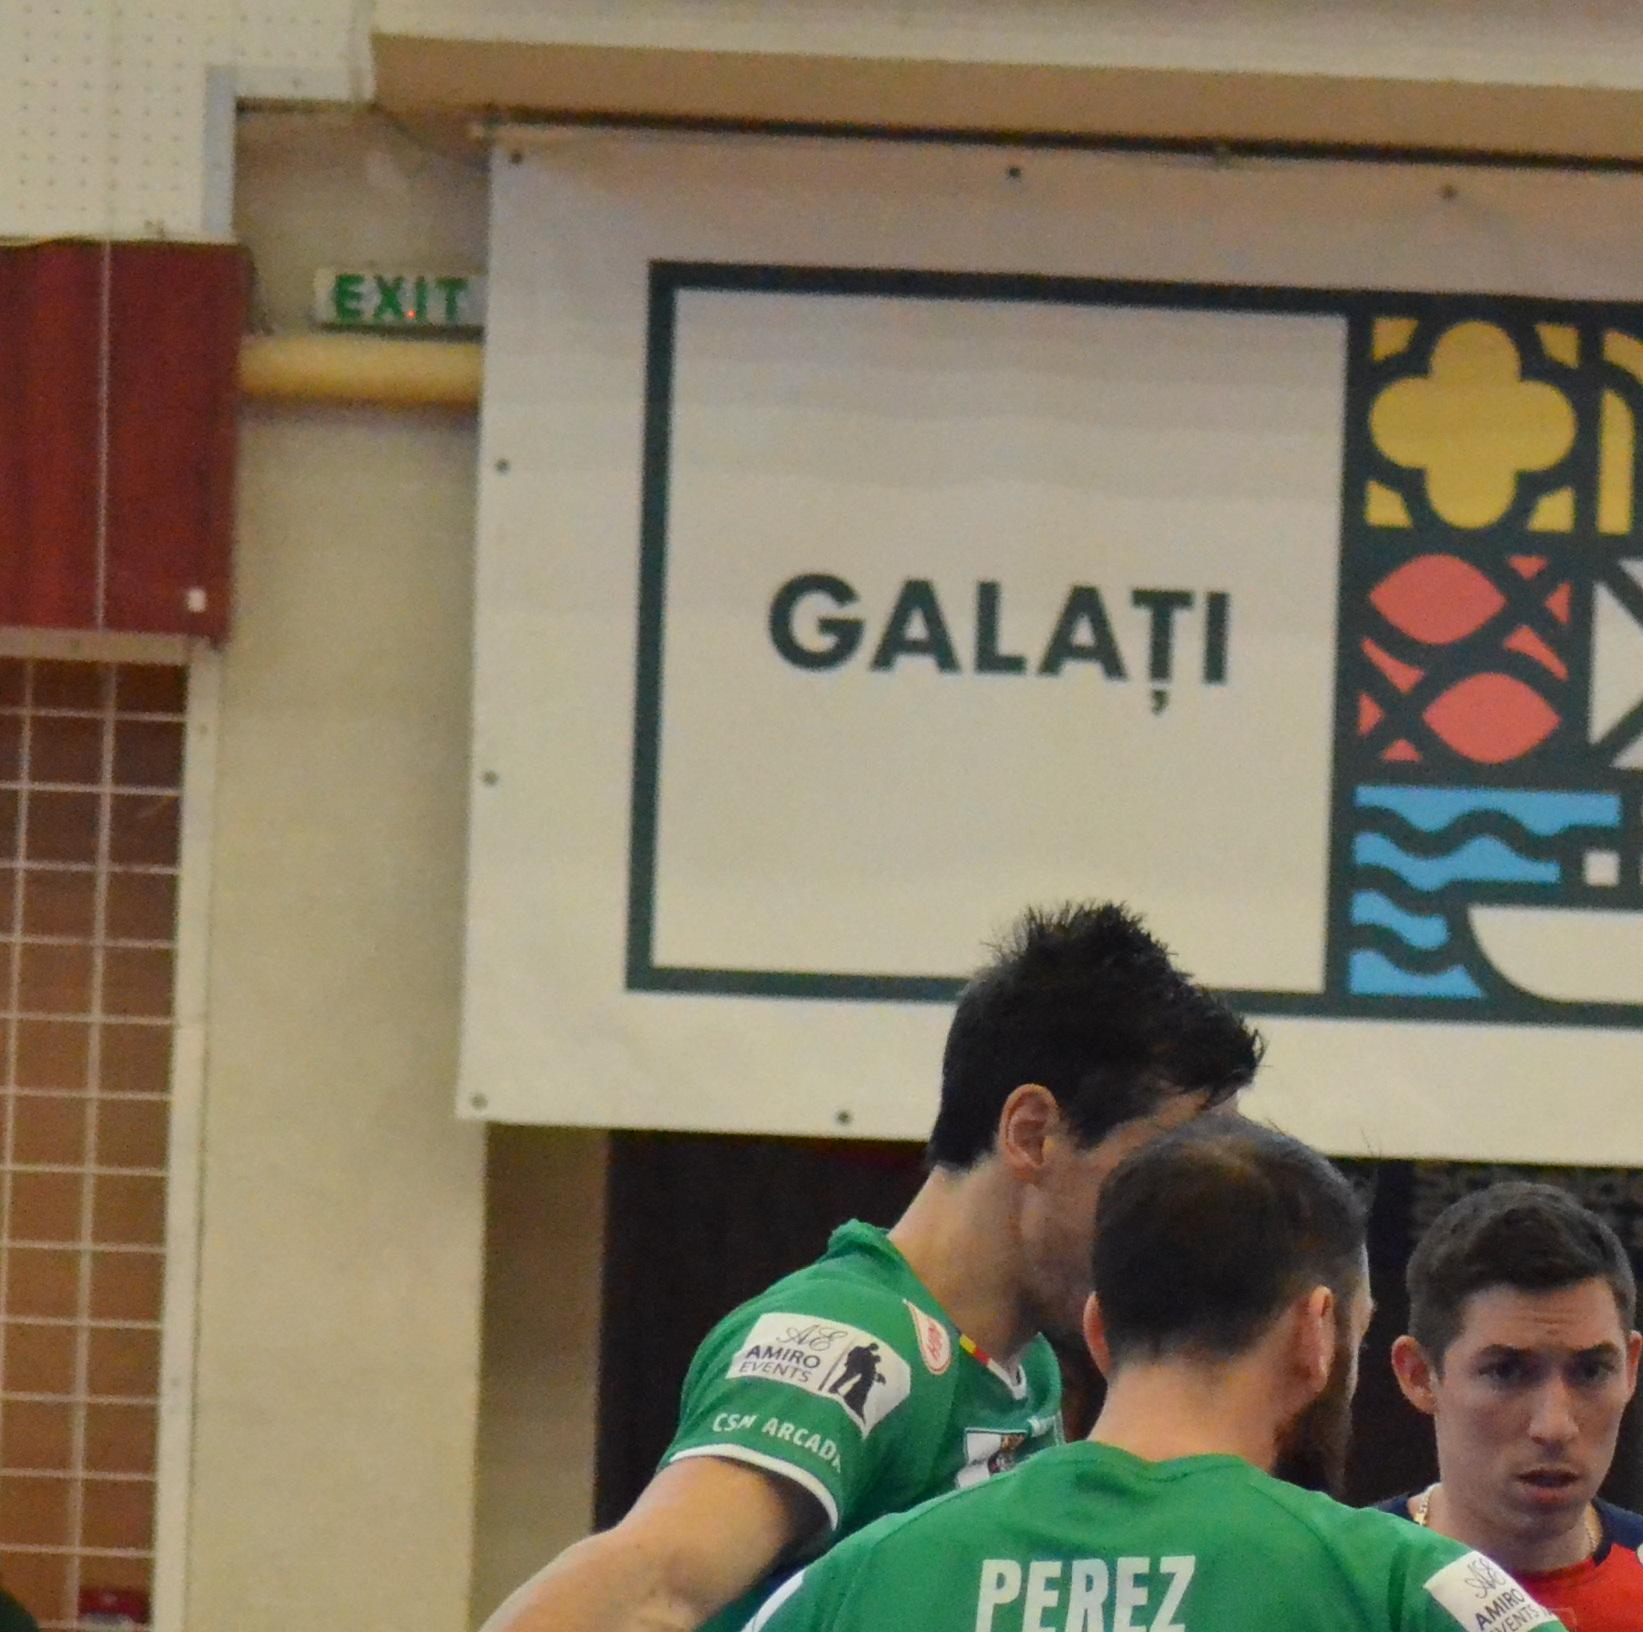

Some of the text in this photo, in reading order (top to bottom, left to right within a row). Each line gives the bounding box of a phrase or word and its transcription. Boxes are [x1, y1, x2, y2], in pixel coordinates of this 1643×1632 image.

[333, 271, 468, 321] EXIT
[768, 573, 1229, 712] GALAȚI
[739, 1361, 816, 1383] EVENTS
[745, 1344, 821, 1369] AMIRO
[713, 1413, 758, 1432] CSM
[1475, 1588, 1525, 1632] AMIRO
